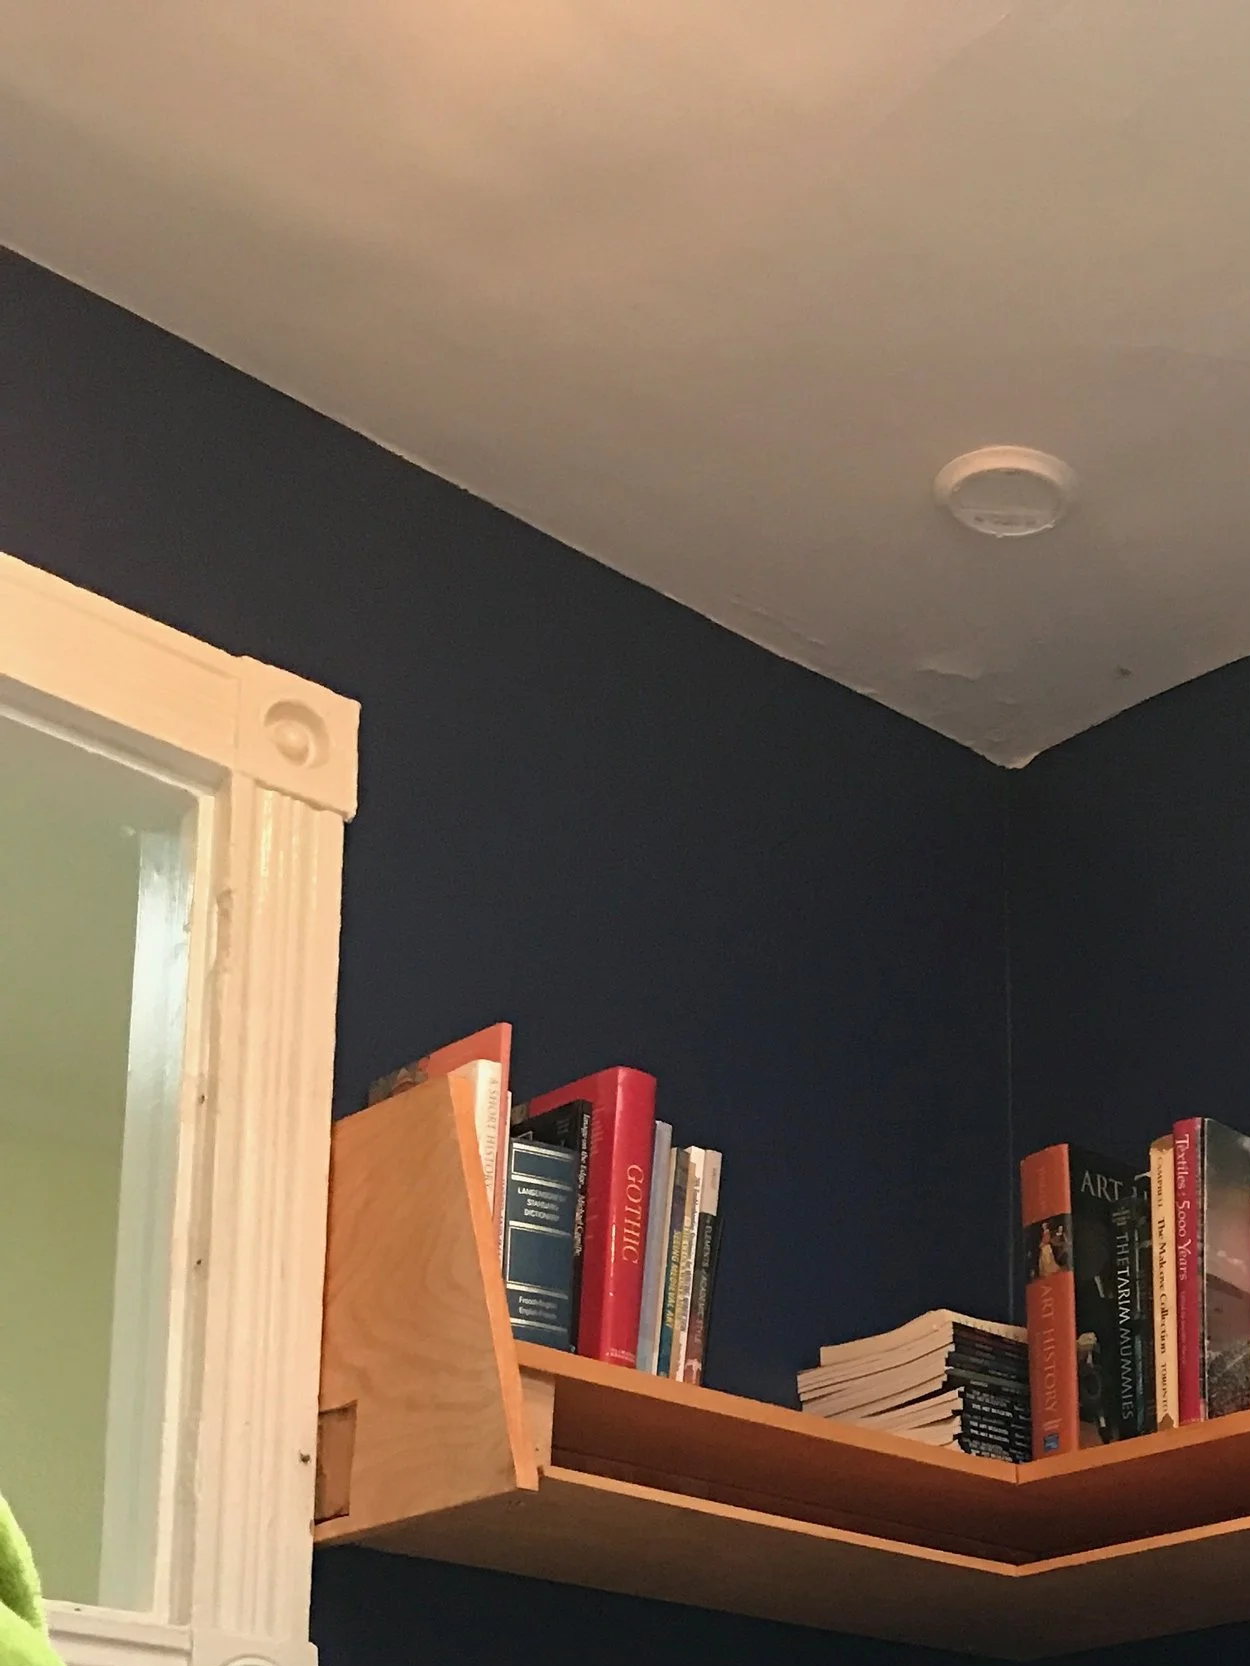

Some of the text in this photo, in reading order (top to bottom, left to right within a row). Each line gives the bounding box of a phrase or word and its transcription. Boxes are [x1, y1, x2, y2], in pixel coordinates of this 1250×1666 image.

[487, 1089, 499, 1131] SHORT
[580, 1114, 591, 1139] Image
[577, 1163, 588, 1185] Edge
[580, 1150, 589, 1163] the
[1080, 1170, 1124, 1201] ART
[622, 1164, 644, 1265] GOTHIC
[1158, 1217, 1166, 1240] The
[701, 1225, 713, 1268] ELEMENTS
[1178, 1238, 1192, 1281] Years
[1041, 1285, 1054, 1320] ART
[1159, 1293, 1169, 1353] Collection
[1043, 1328, 1058, 1412] HISTORY
[1119, 1328, 1134, 1420] MUMMIES
